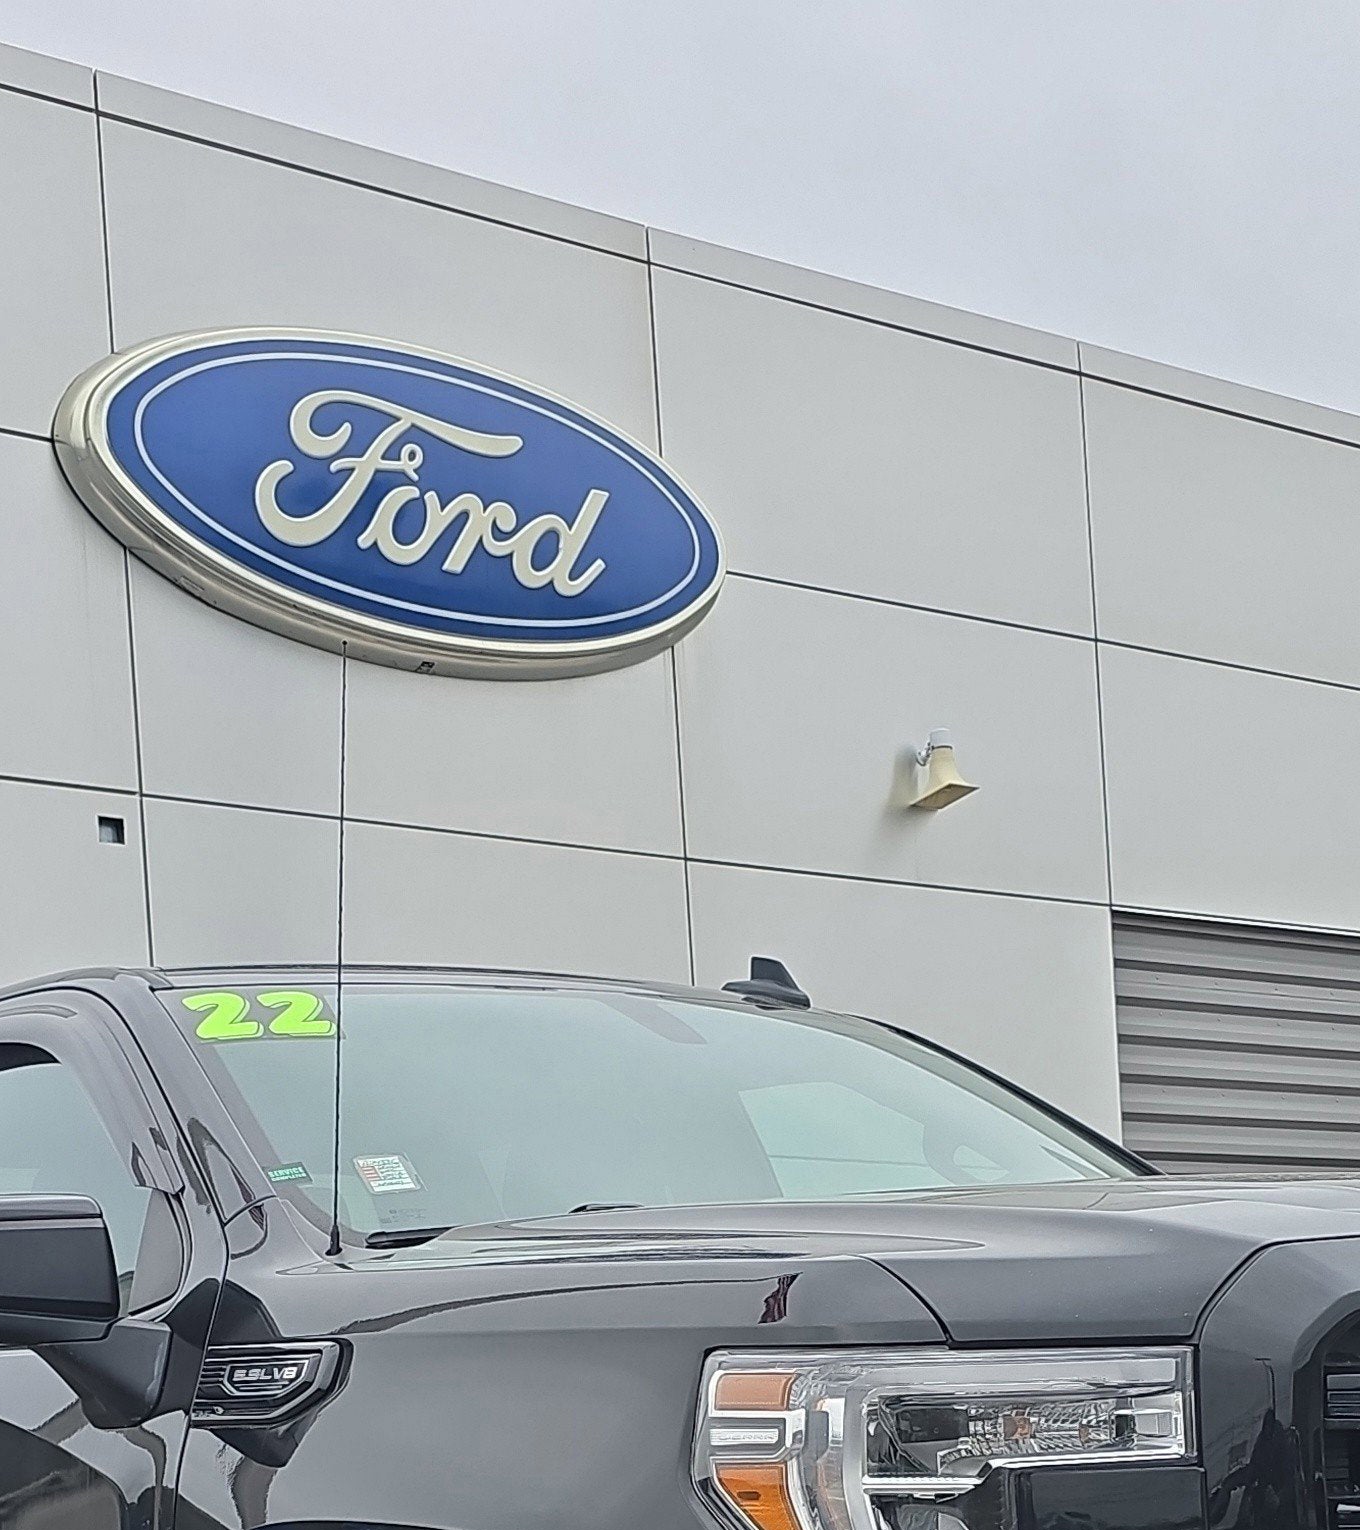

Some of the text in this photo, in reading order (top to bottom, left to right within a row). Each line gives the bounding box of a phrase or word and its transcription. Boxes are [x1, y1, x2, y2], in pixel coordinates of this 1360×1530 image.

[254, 388, 612, 598] Ford
[181, 990, 336, 1040] 22
[267, 1166, 305, 1178] SERVICE
[272, 1366, 298, 1380] V8
